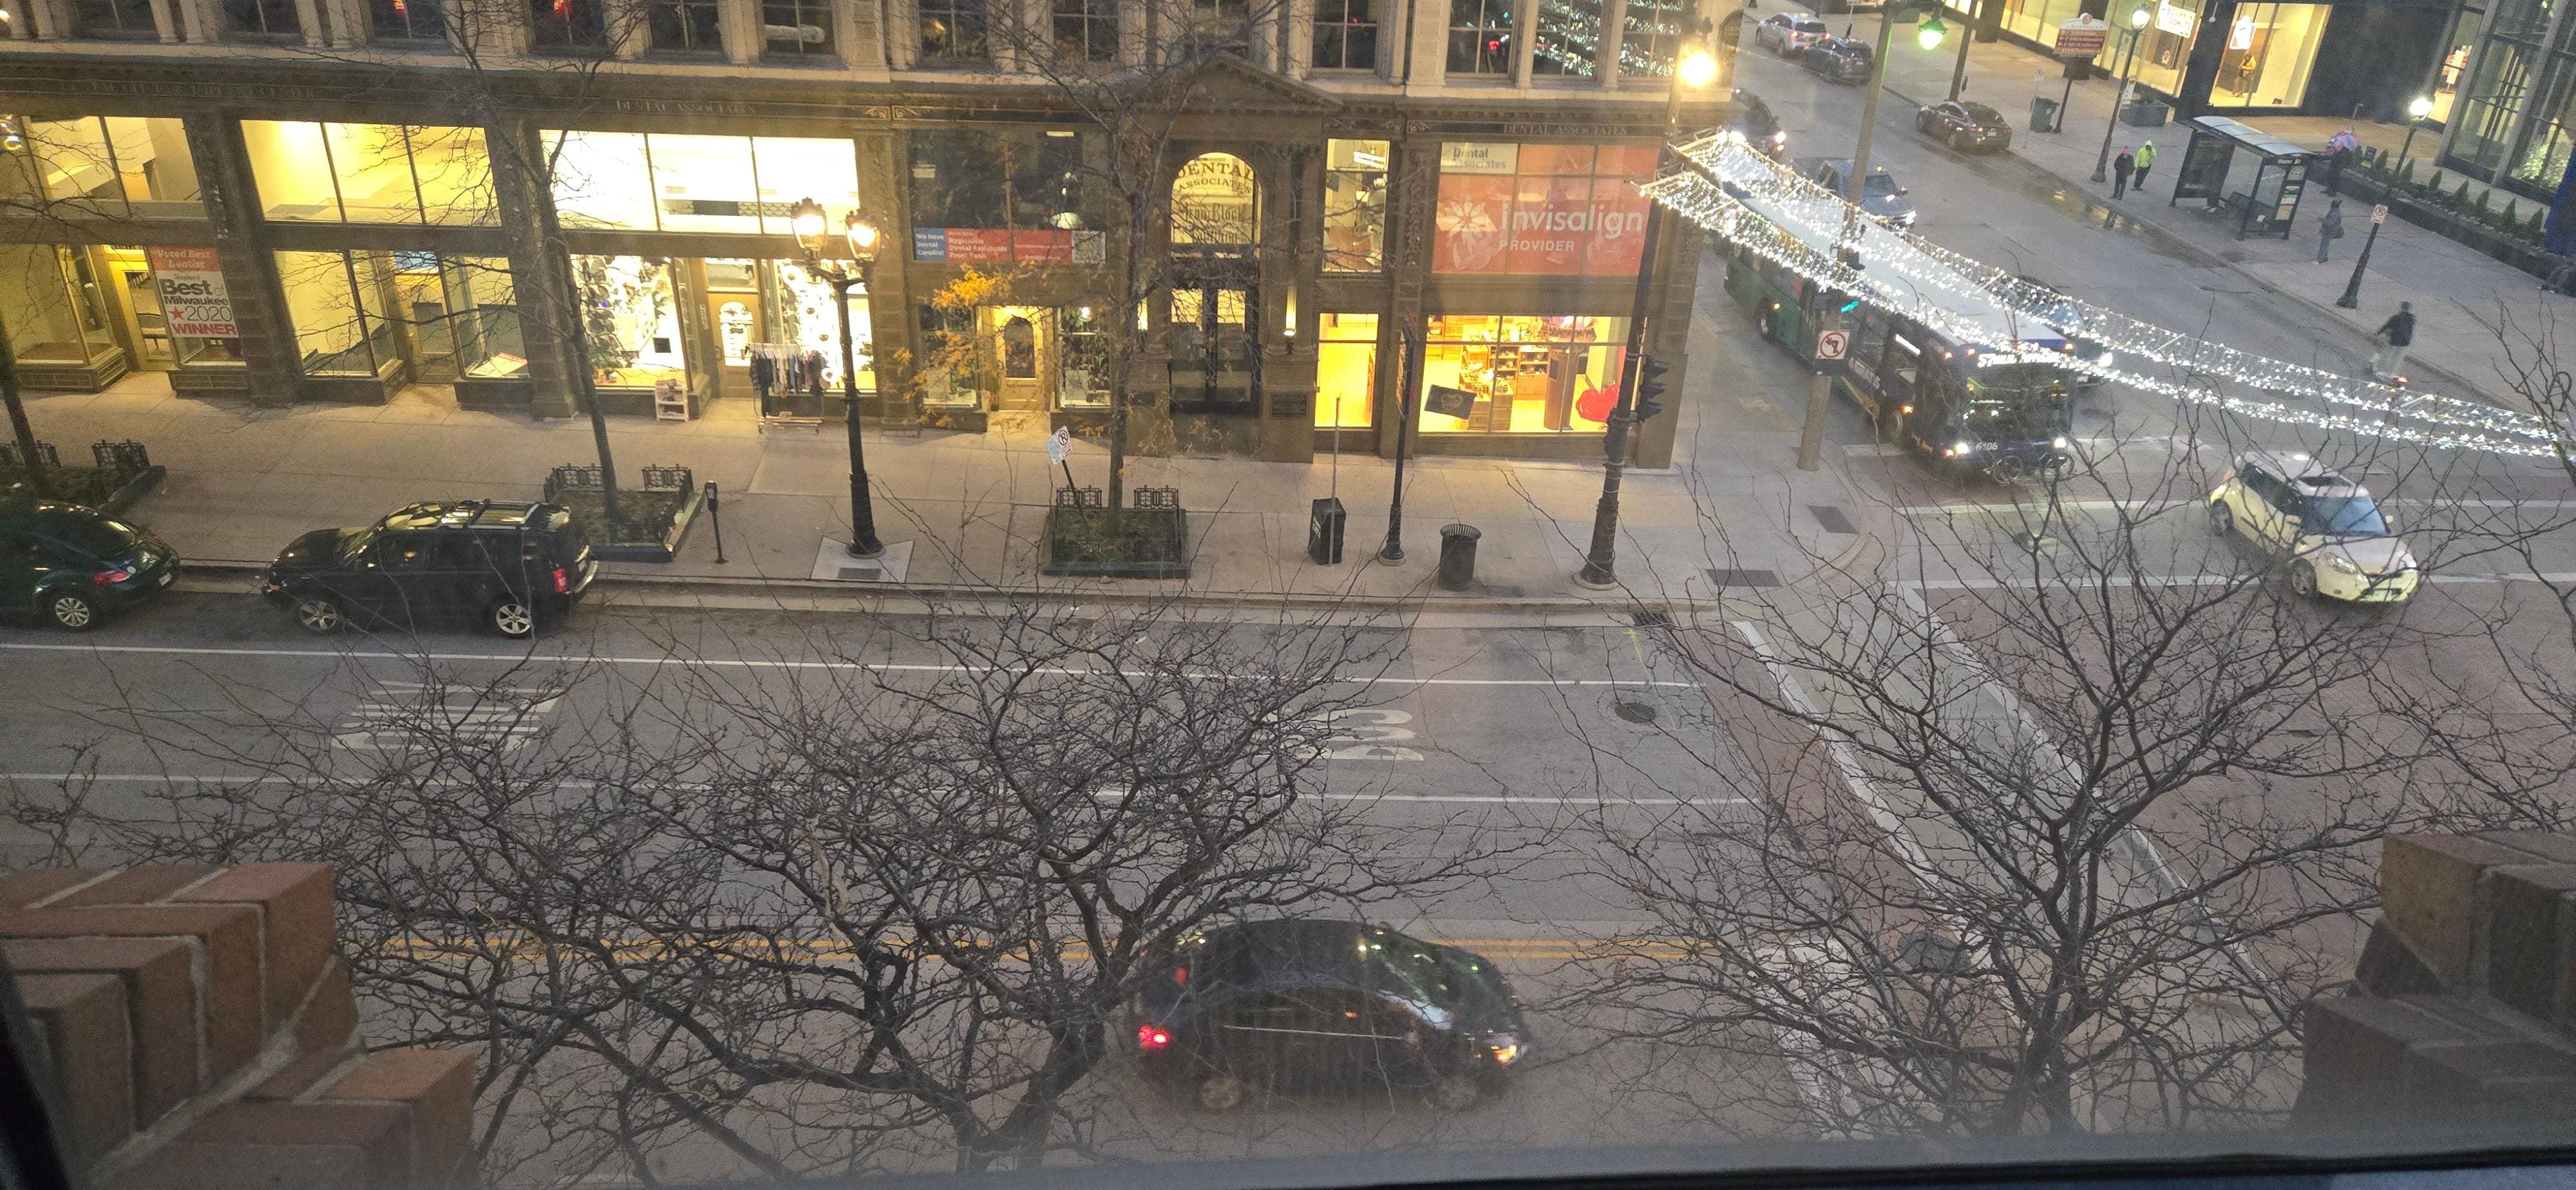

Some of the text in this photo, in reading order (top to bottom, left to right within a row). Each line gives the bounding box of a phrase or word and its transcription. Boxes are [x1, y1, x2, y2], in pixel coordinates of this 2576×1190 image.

[1504, 123, 1628, 135] DENTAL ASSOCIATES
[1453, 147, 1489, 158] Dental
[1452, 158, 1506, 169] Associates
[1178, 178, 1253, 194] ASSOCIATES
[1499, 240, 1575, 252] PROVIDER
[157, 249, 186, 258] Voted
[169, 260, 205, 269] Dentist
[158, 279, 213, 296] Best
[164, 296, 229, 305] Milwaukee
[184, 305, 232, 322] 2020
[171, 323, 237, 335] WINNER
